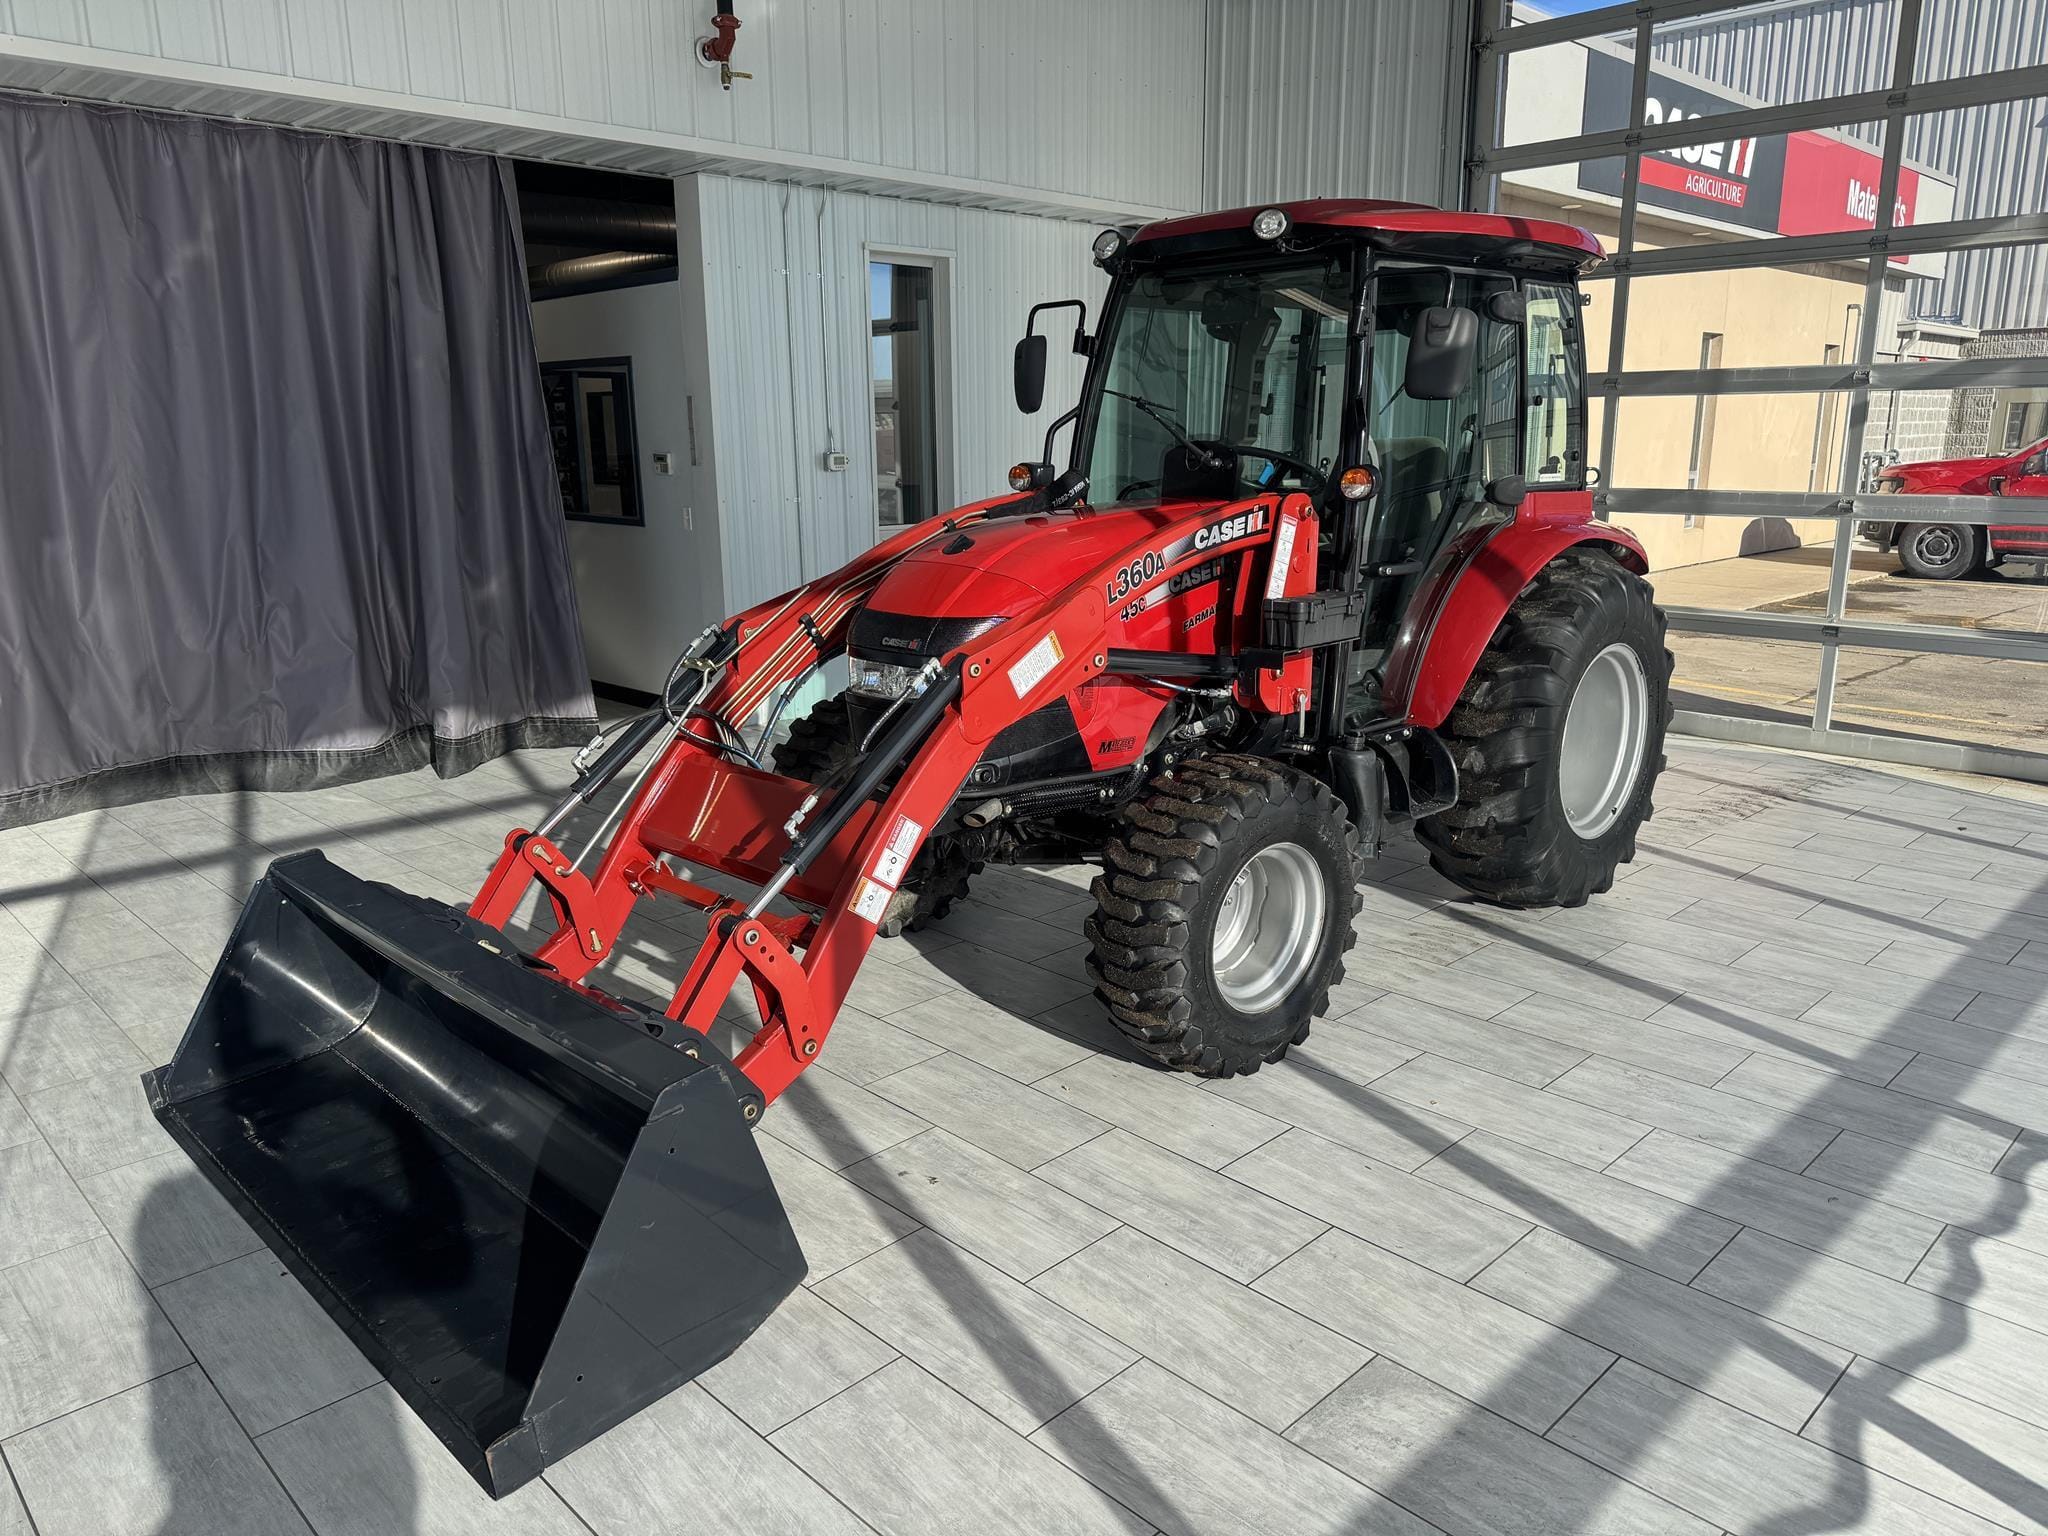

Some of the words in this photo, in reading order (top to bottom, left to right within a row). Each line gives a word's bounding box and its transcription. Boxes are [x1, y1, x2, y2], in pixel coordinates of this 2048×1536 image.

[1685, 174, 1742, 203] AGRICULTURE
[1194, 516, 1246, 549] CASE
[1106, 551, 1166, 606] L360A
[1169, 563, 1211, 594] CASE
[1120, 597, 1146, 622] 45C
